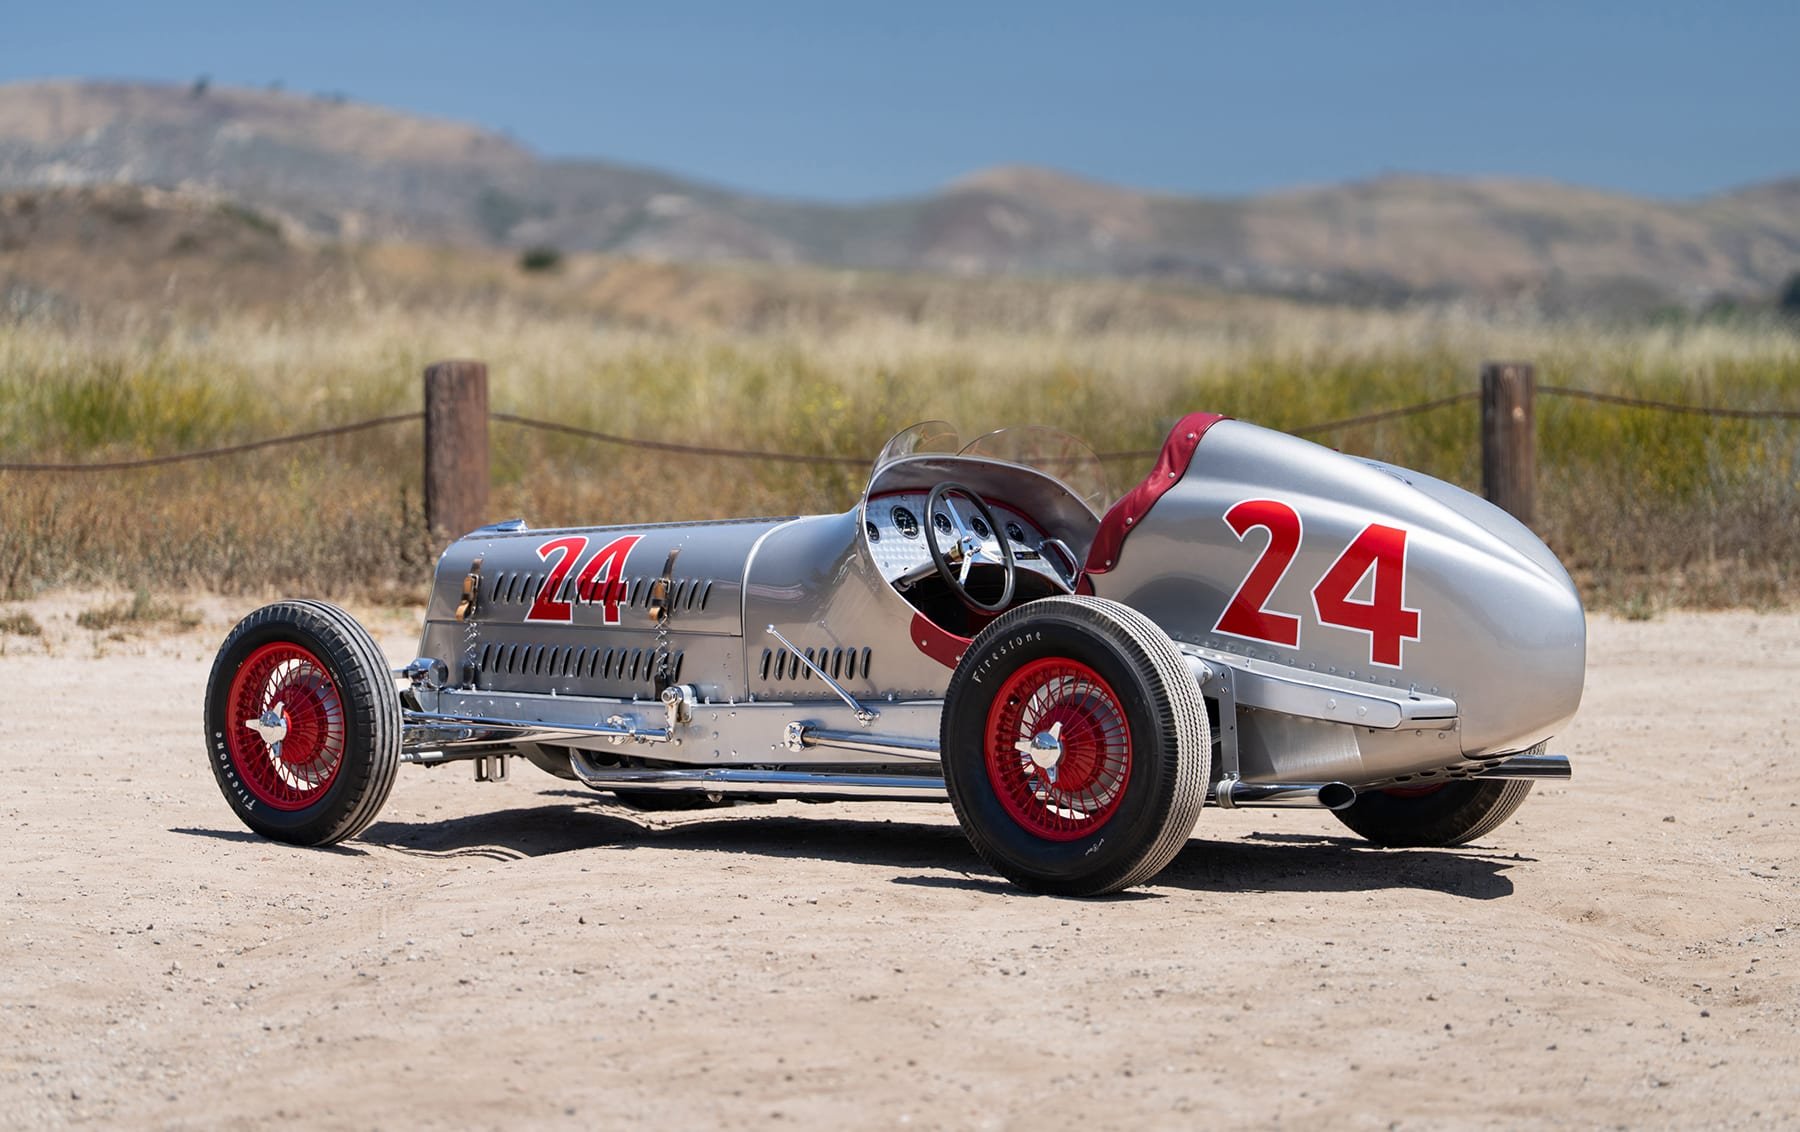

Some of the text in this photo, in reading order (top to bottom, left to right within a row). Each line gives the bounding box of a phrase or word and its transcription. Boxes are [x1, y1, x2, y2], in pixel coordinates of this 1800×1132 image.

[523, 534, 646, 625] 24
[1211, 497, 1421, 669] 24
[971, 631, 1041, 683] Firestone
